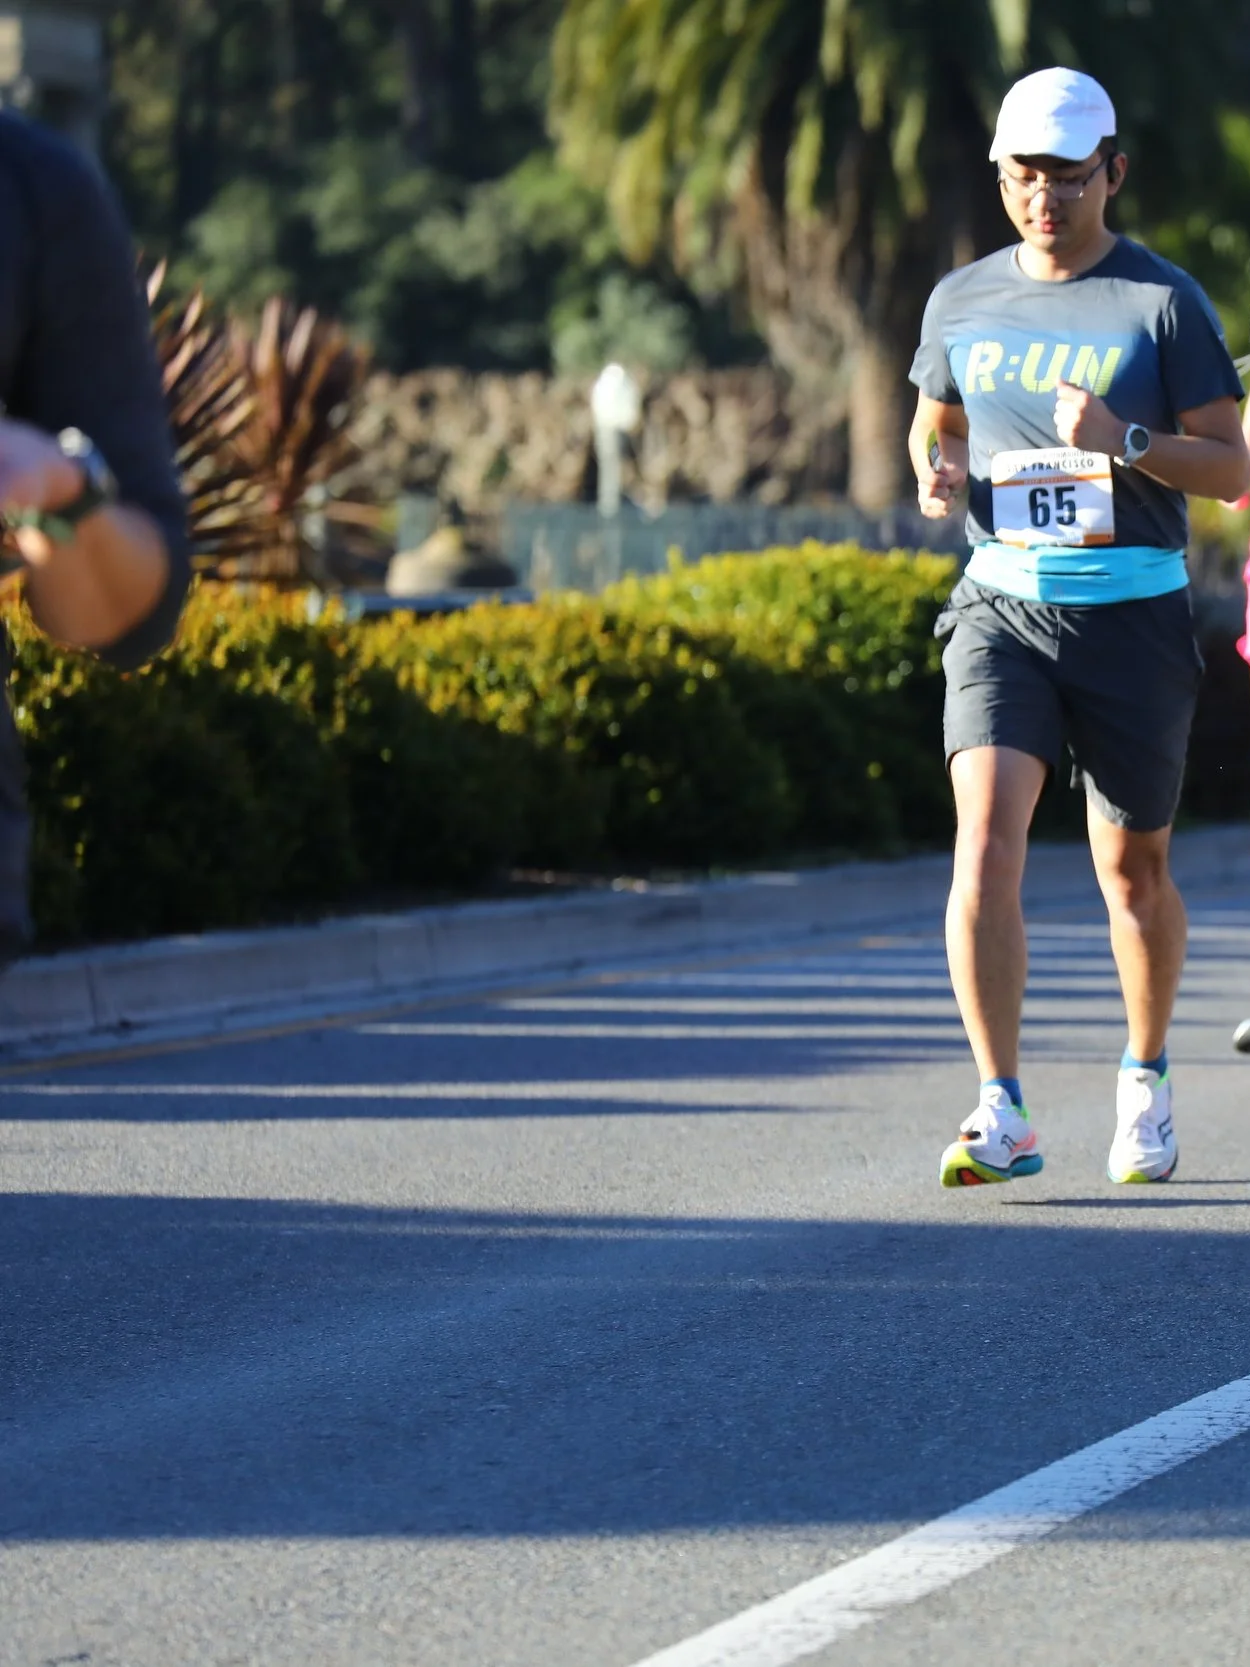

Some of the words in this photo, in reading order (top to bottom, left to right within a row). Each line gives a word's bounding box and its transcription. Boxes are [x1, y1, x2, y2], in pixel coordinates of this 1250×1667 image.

[965, 340, 1122, 396] R:UN
[1032, 458, 1095, 473] FRANCISCO
[1028, 485, 1076, 528] 65
